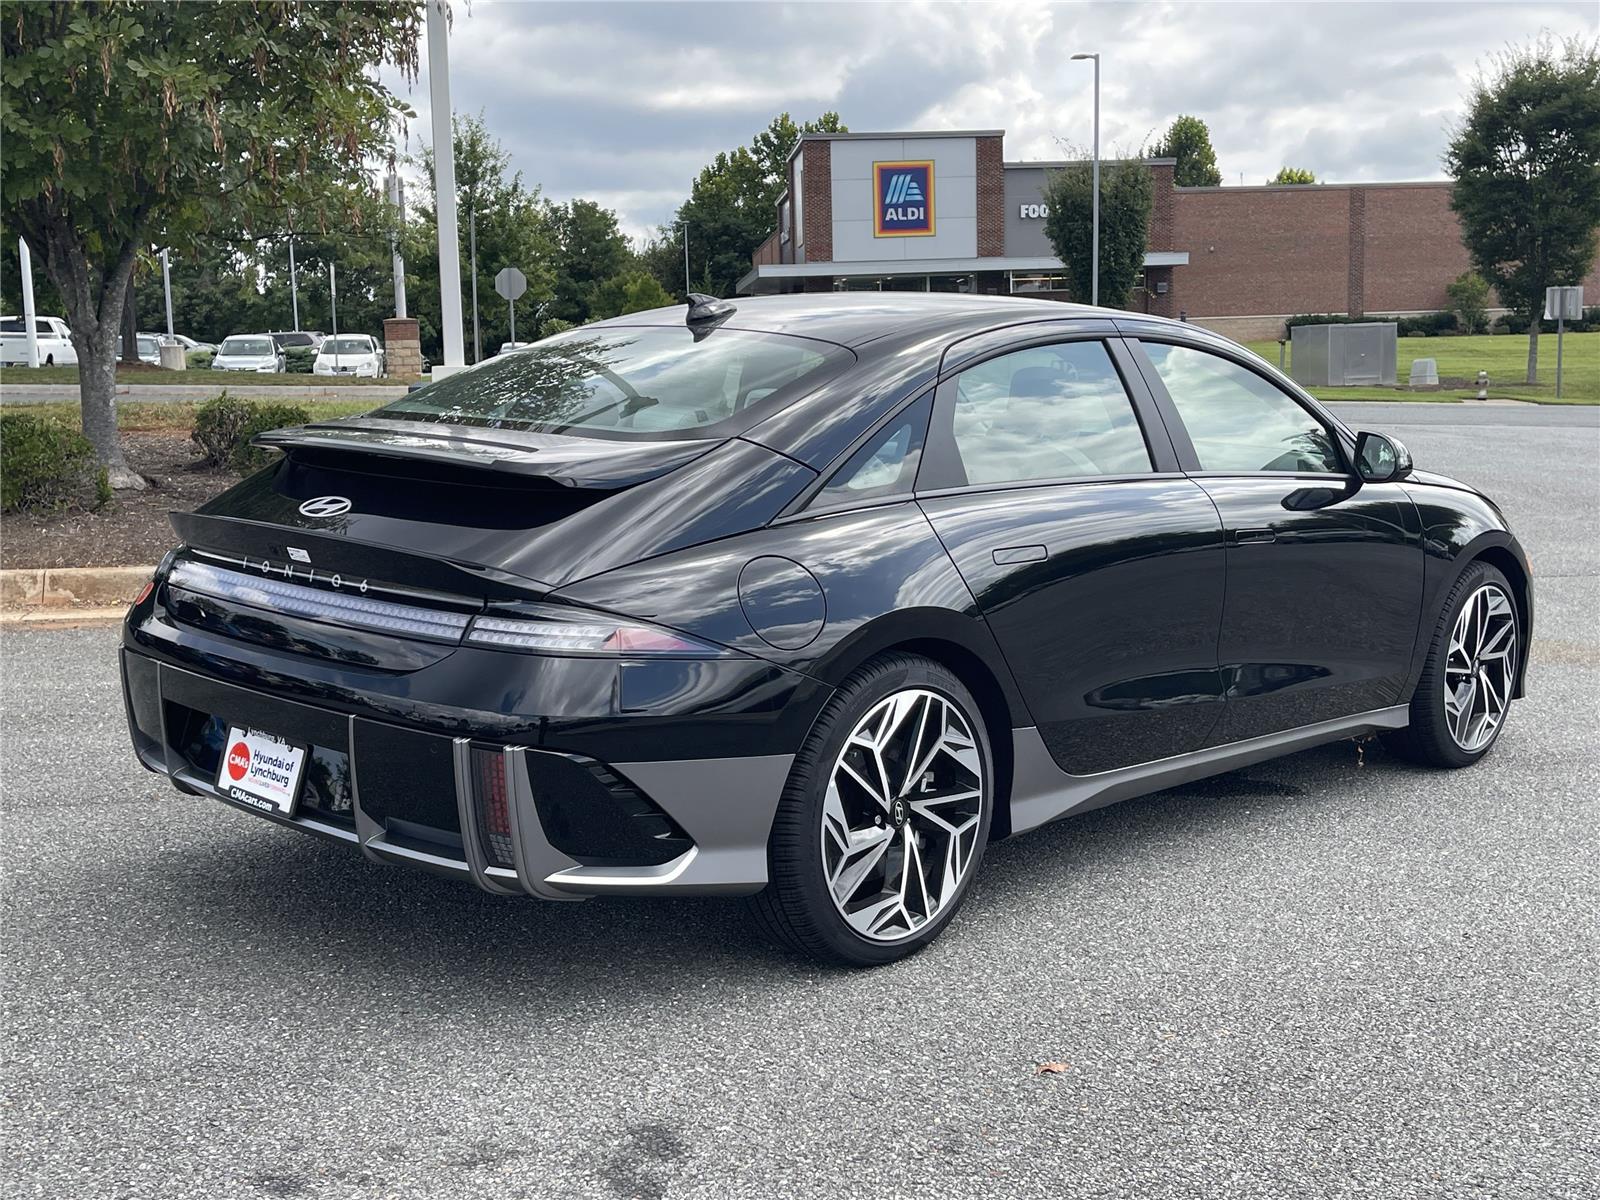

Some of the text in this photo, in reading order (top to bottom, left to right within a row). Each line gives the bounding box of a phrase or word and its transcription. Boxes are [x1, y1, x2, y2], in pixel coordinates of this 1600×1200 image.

[885, 207, 925, 221] ALDI
[1020, 204, 1050, 218] FOO
[253, 749, 295, 772] Hyundai of
[250, 762, 289, 787] Lynchburg
[230, 787, 273, 811] CMAcars.com
